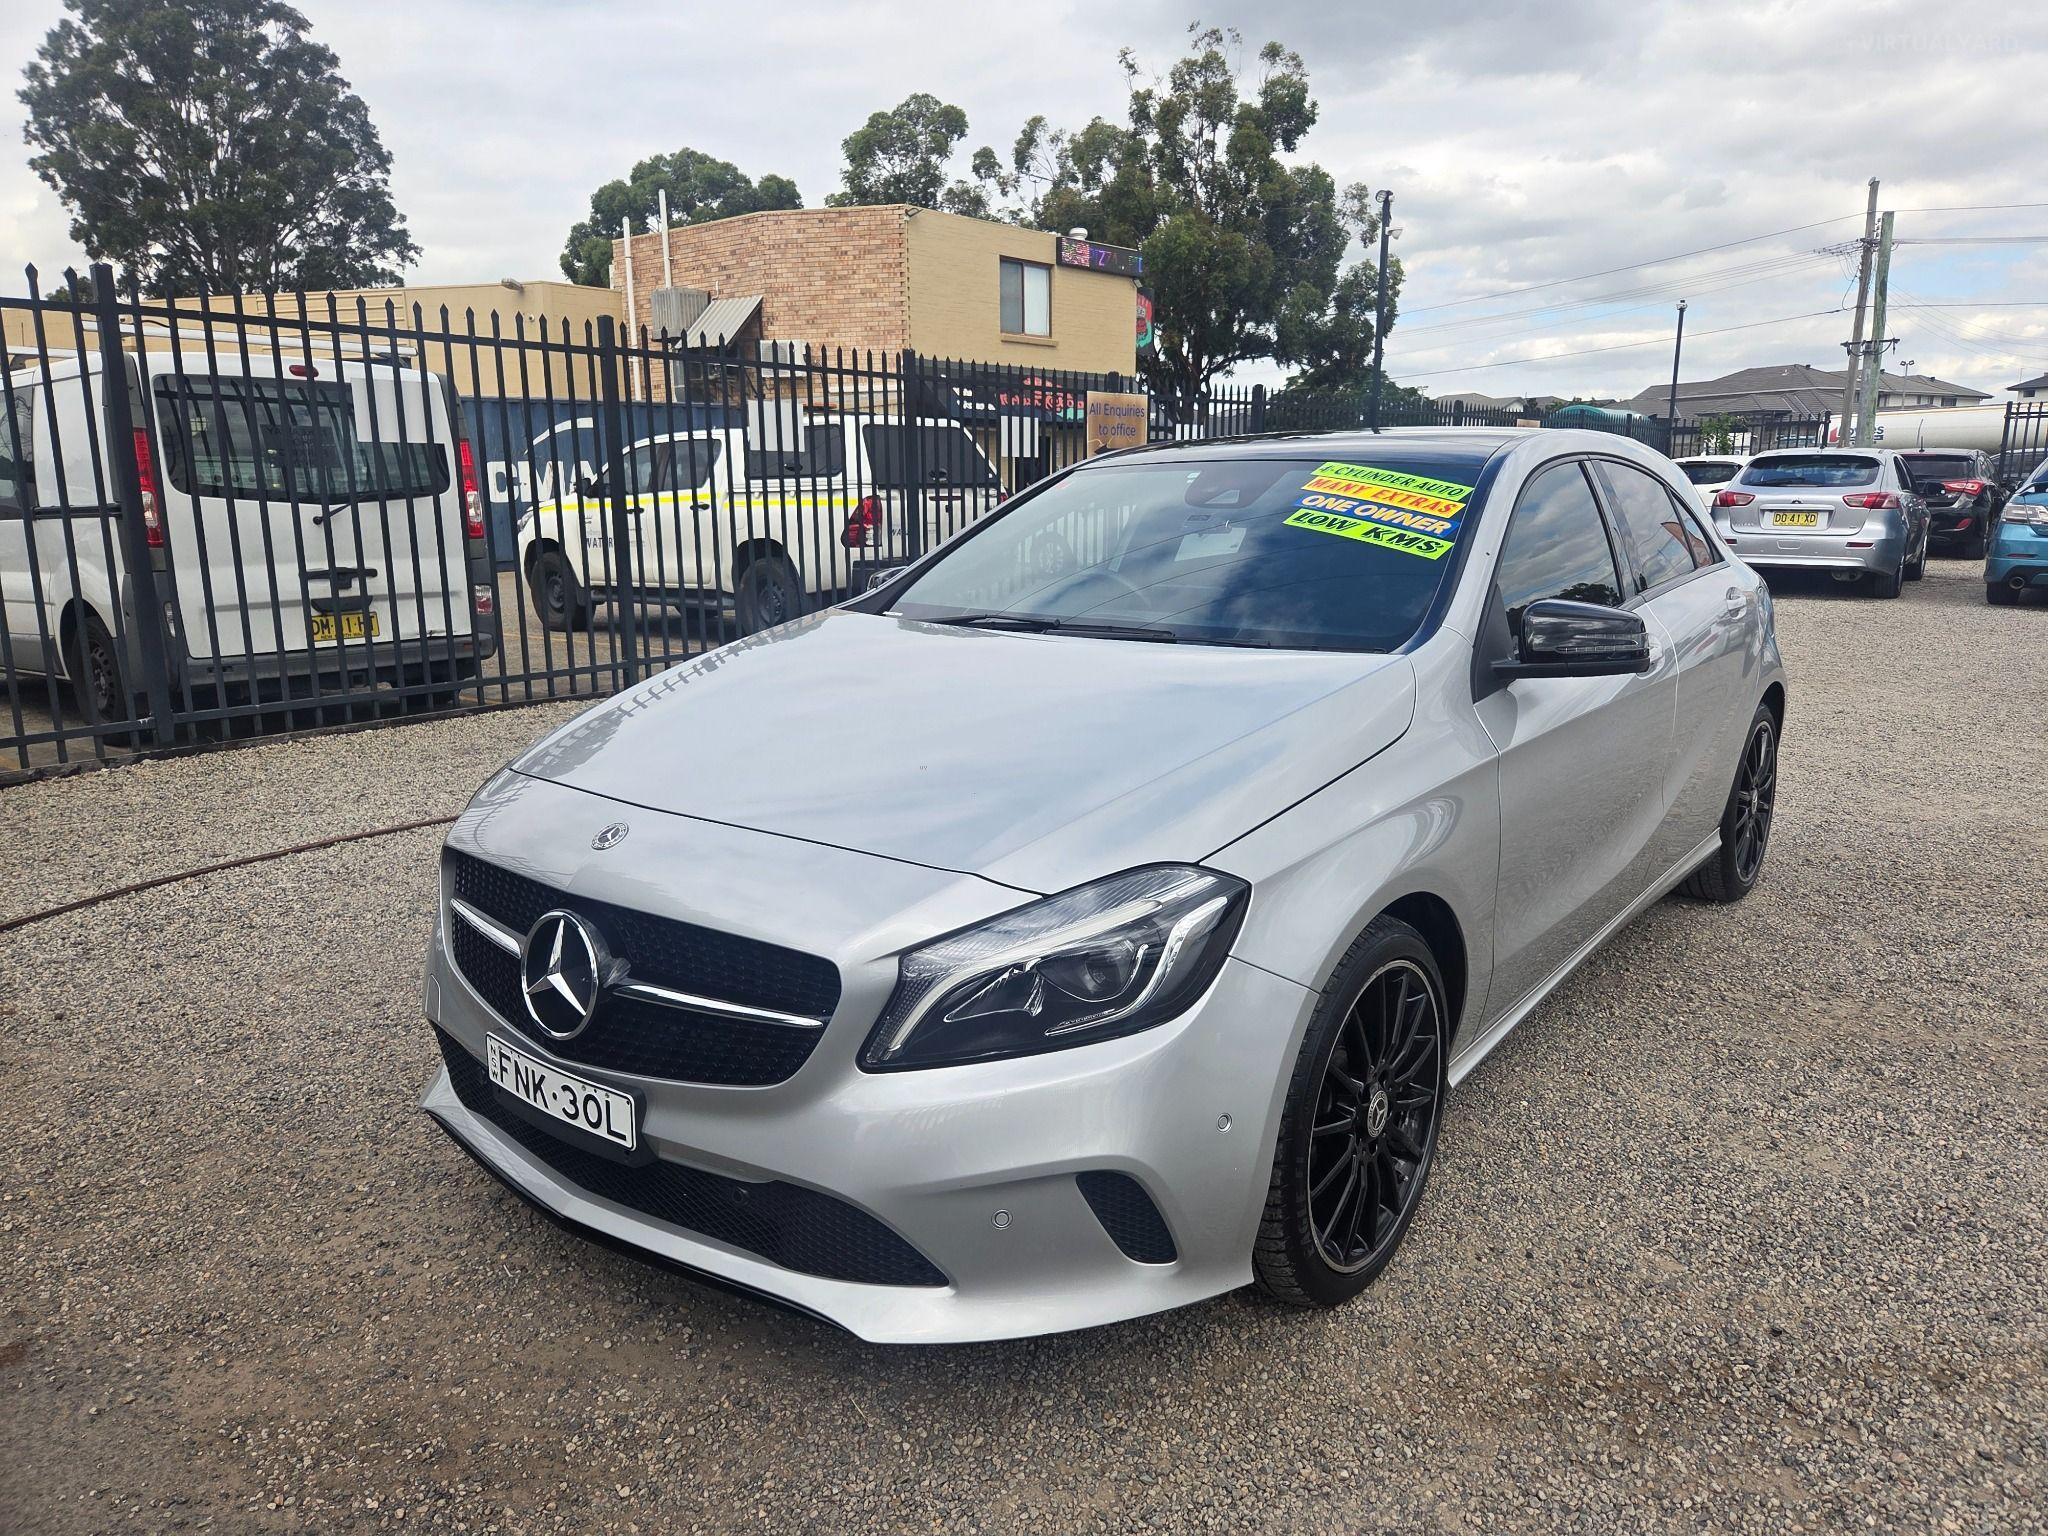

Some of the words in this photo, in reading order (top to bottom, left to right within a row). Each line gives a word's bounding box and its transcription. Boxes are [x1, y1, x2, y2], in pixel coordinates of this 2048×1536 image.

[1089, 402, 1101, 416] All
[1104, 403, 1145, 419] Enquiries
[1098, 423, 1109, 436] to
[1110, 423, 1137, 437] office
[1309, 478, 1366, 495] MANY
[1370, 488, 1458, 514] EXTRAS
[1412, 480, 1466, 497] AUTO
[1301, 494, 1359, 512] ONE
[1353, 504, 1452, 535] OWNER
[1291, 511, 1361, 532] LOW
[1360, 526, 1444, 553] KMS
[583, 537, 614, 548] WATR
